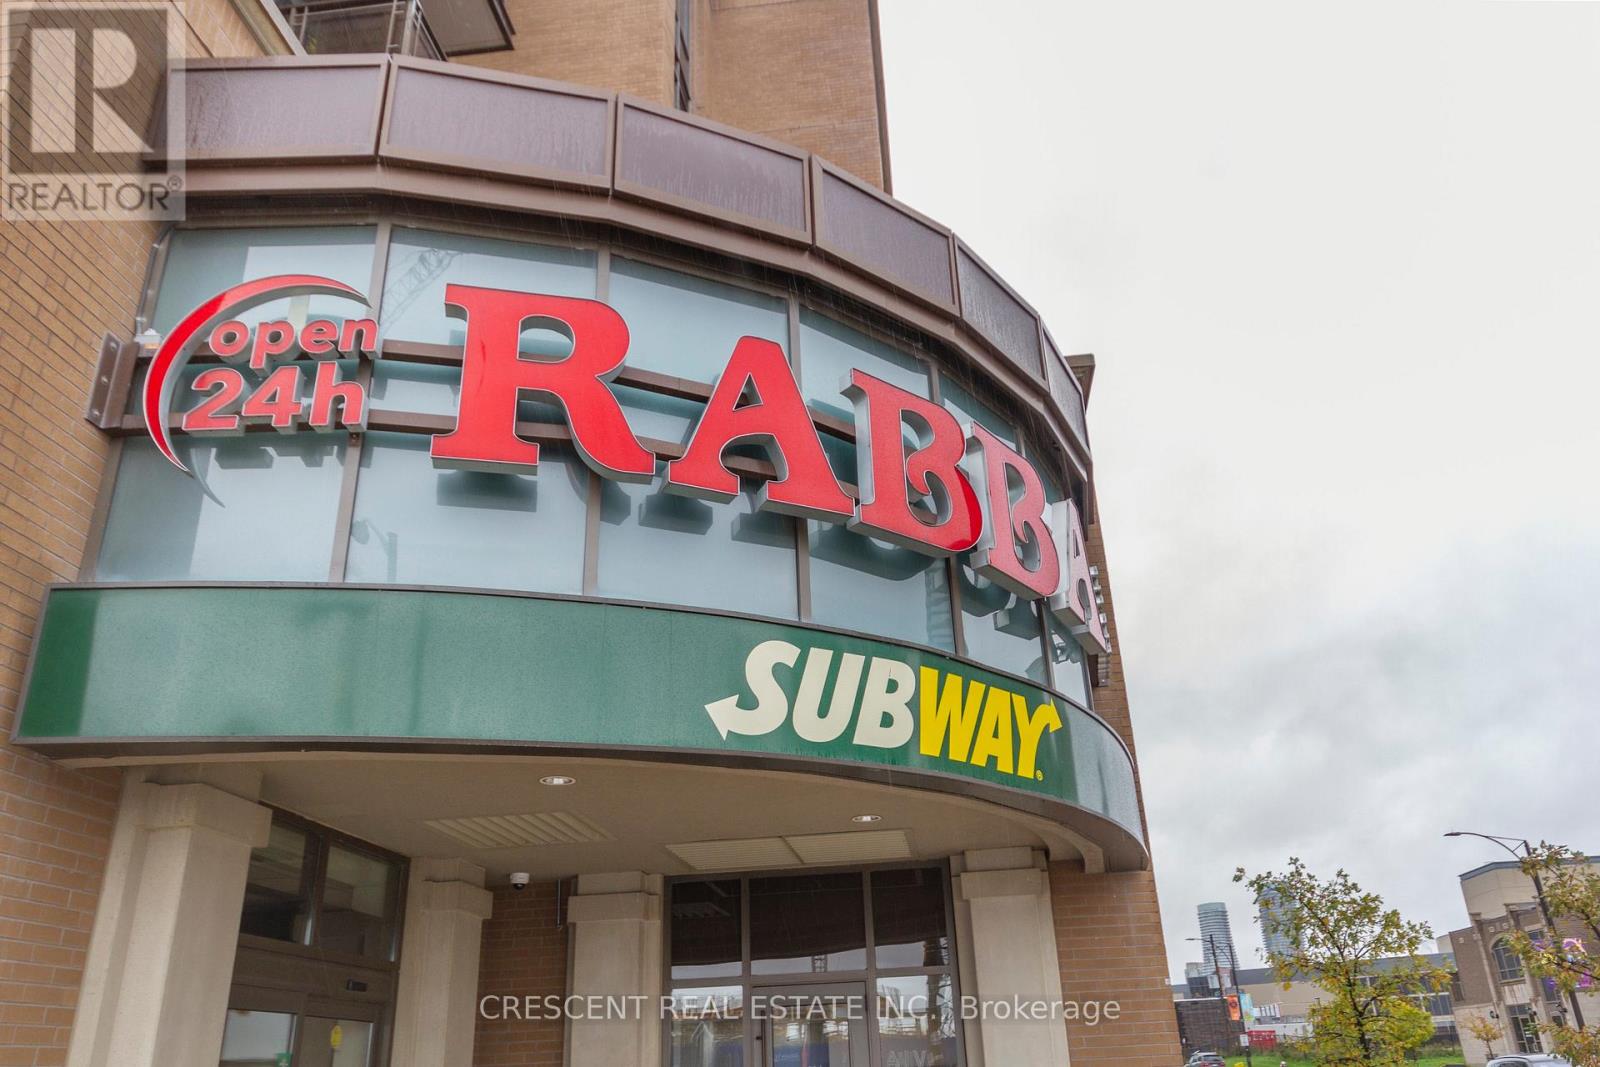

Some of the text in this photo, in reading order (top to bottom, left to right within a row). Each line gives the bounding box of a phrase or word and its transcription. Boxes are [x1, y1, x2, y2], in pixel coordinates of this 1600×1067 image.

[182, 360, 368, 432] 24h
[208, 317, 379, 374] open
[430, 283, 1111, 655] RABBA
[705, 640, 1063, 781] SUBWAY
